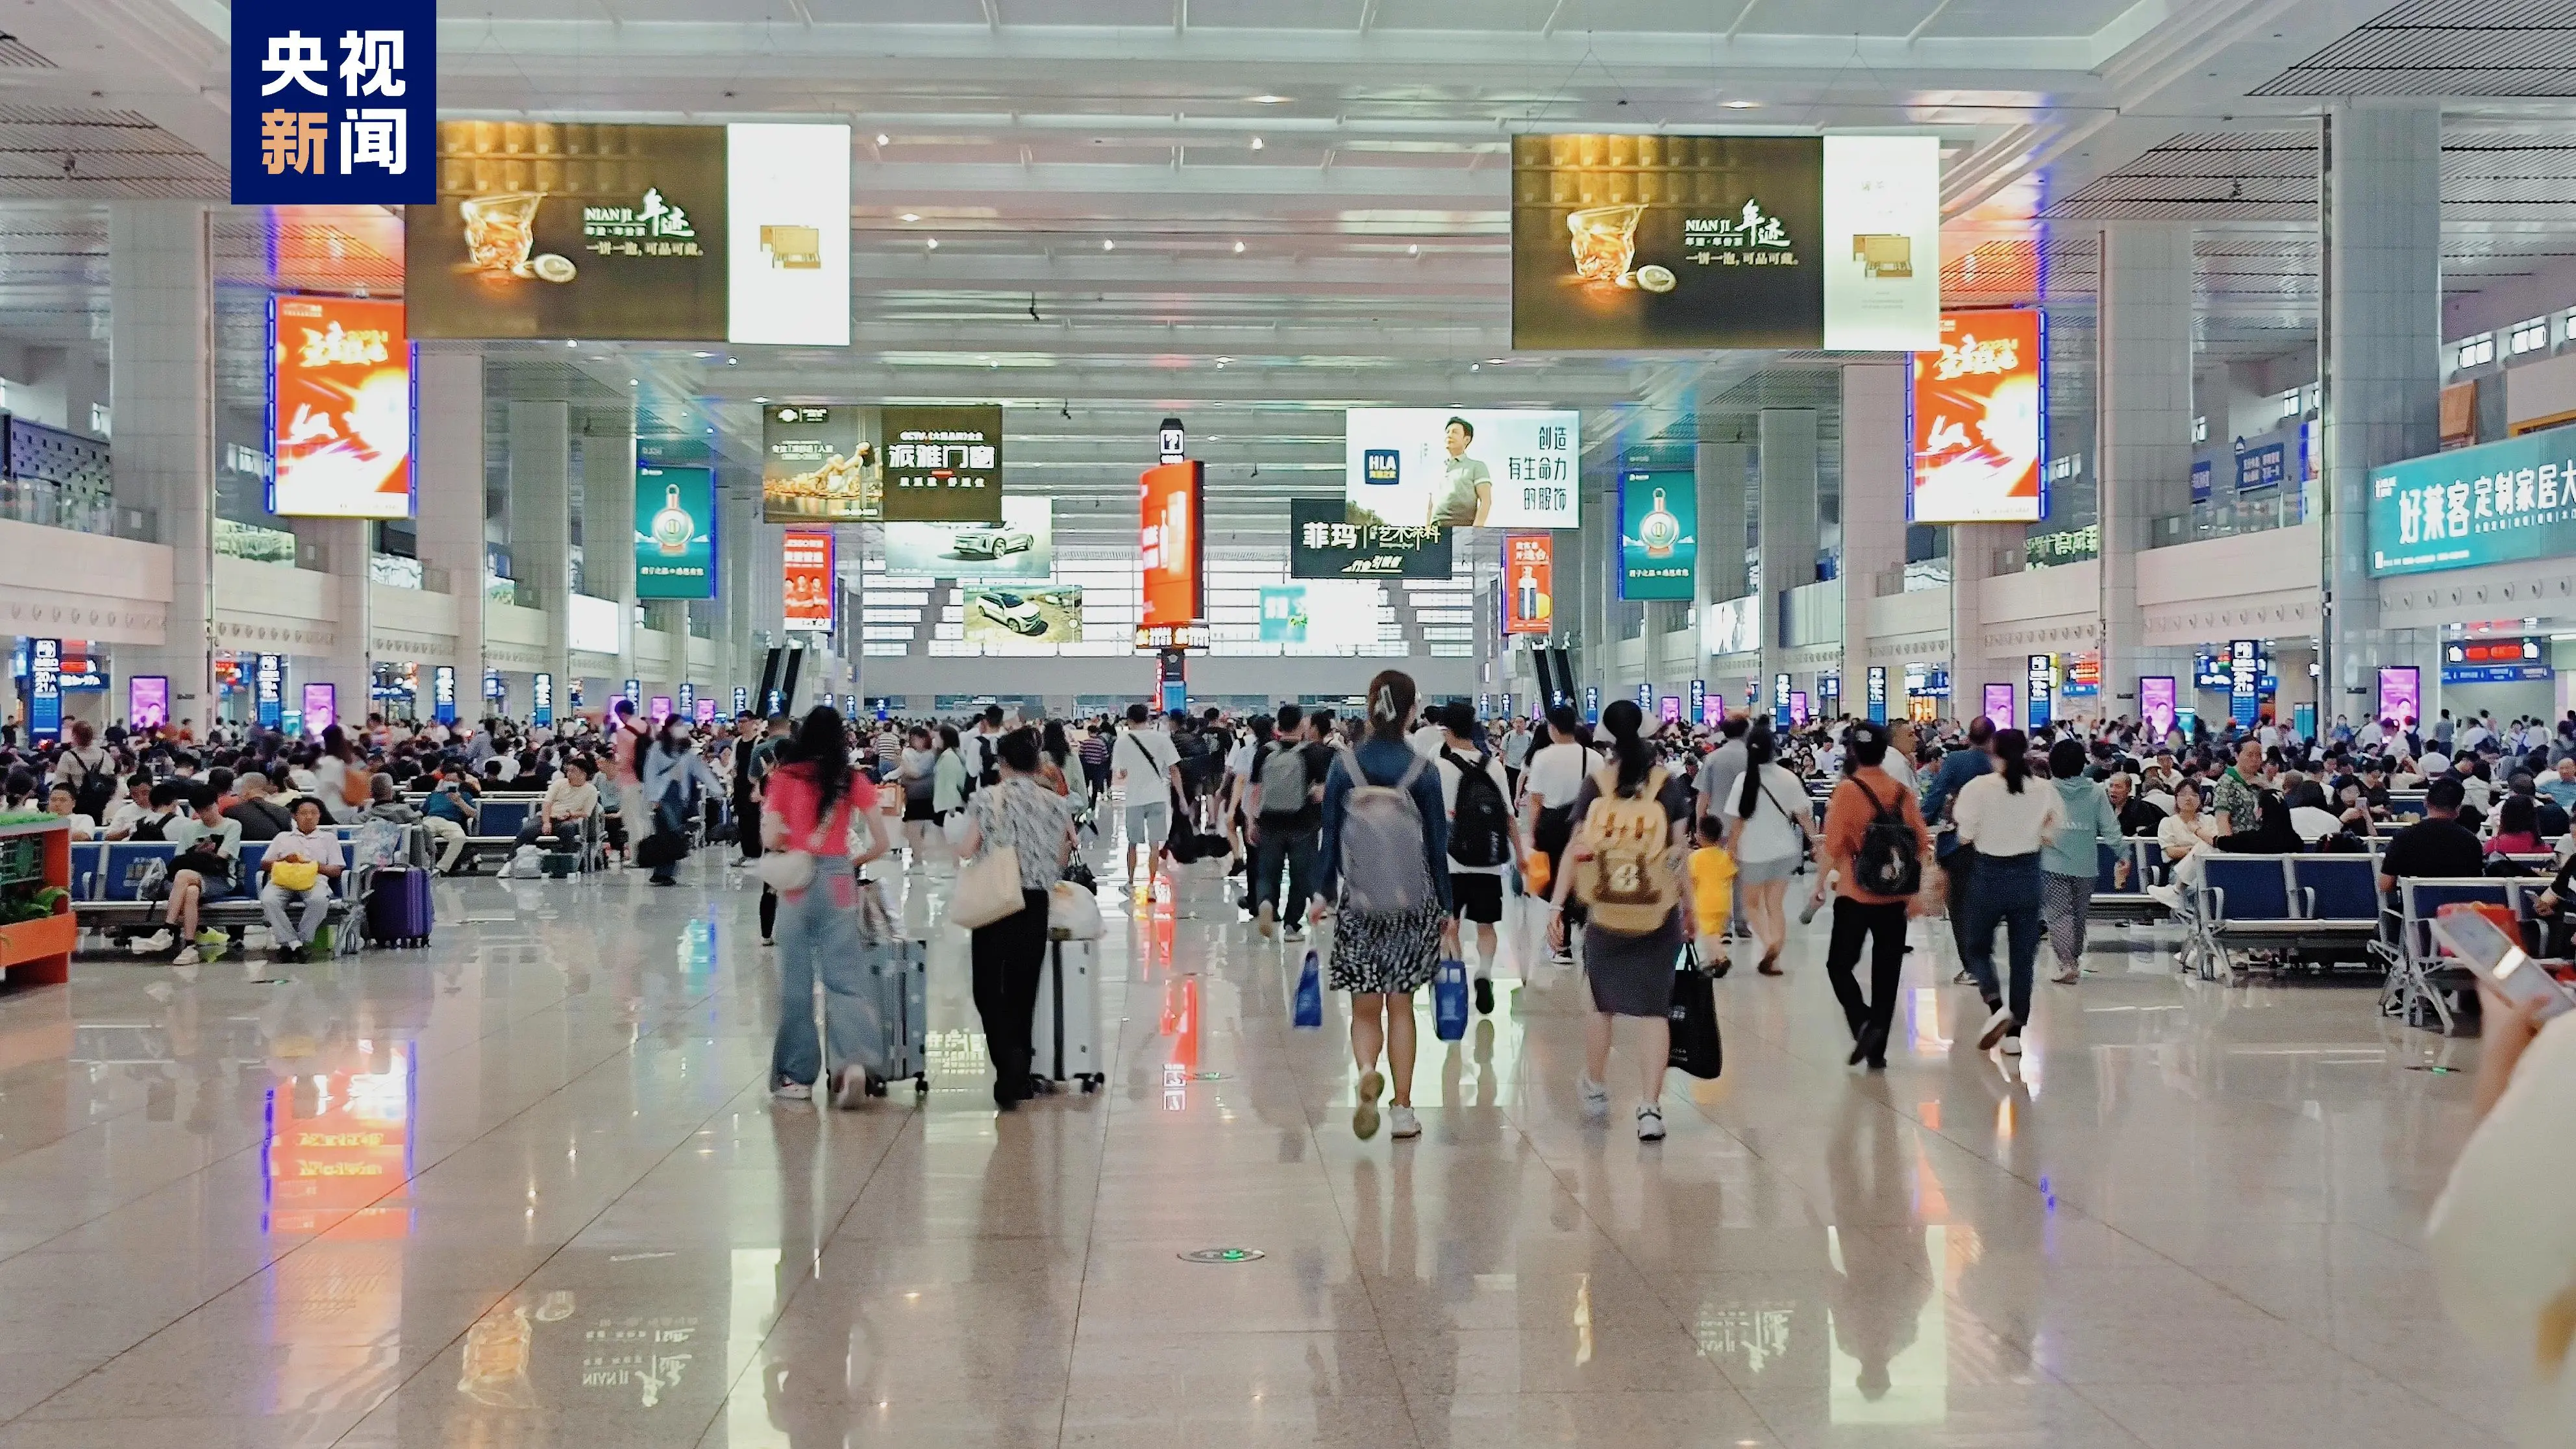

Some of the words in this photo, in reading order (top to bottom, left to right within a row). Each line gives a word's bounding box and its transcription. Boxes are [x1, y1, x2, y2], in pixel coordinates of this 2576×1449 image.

[585, 208, 620, 221] NIAN
[620, 208, 632, 223] JI
[637, 188, 695, 236] 年迹
[1734, 198, 1791, 247] 年迹
[1685, 219, 1718, 232] NIAN
[1720, 219, 1730, 234] JI
[1539, 427, 1567, 450] 创造
[889, 444, 995, 469] 派雅门窗
[1368, 454, 1396, 470] HLA
[1509, 456, 1567, 480] 有生命力
[1524, 487, 1567, 510] 的服饰
[1302, 521, 1357, 550] 菲玛
